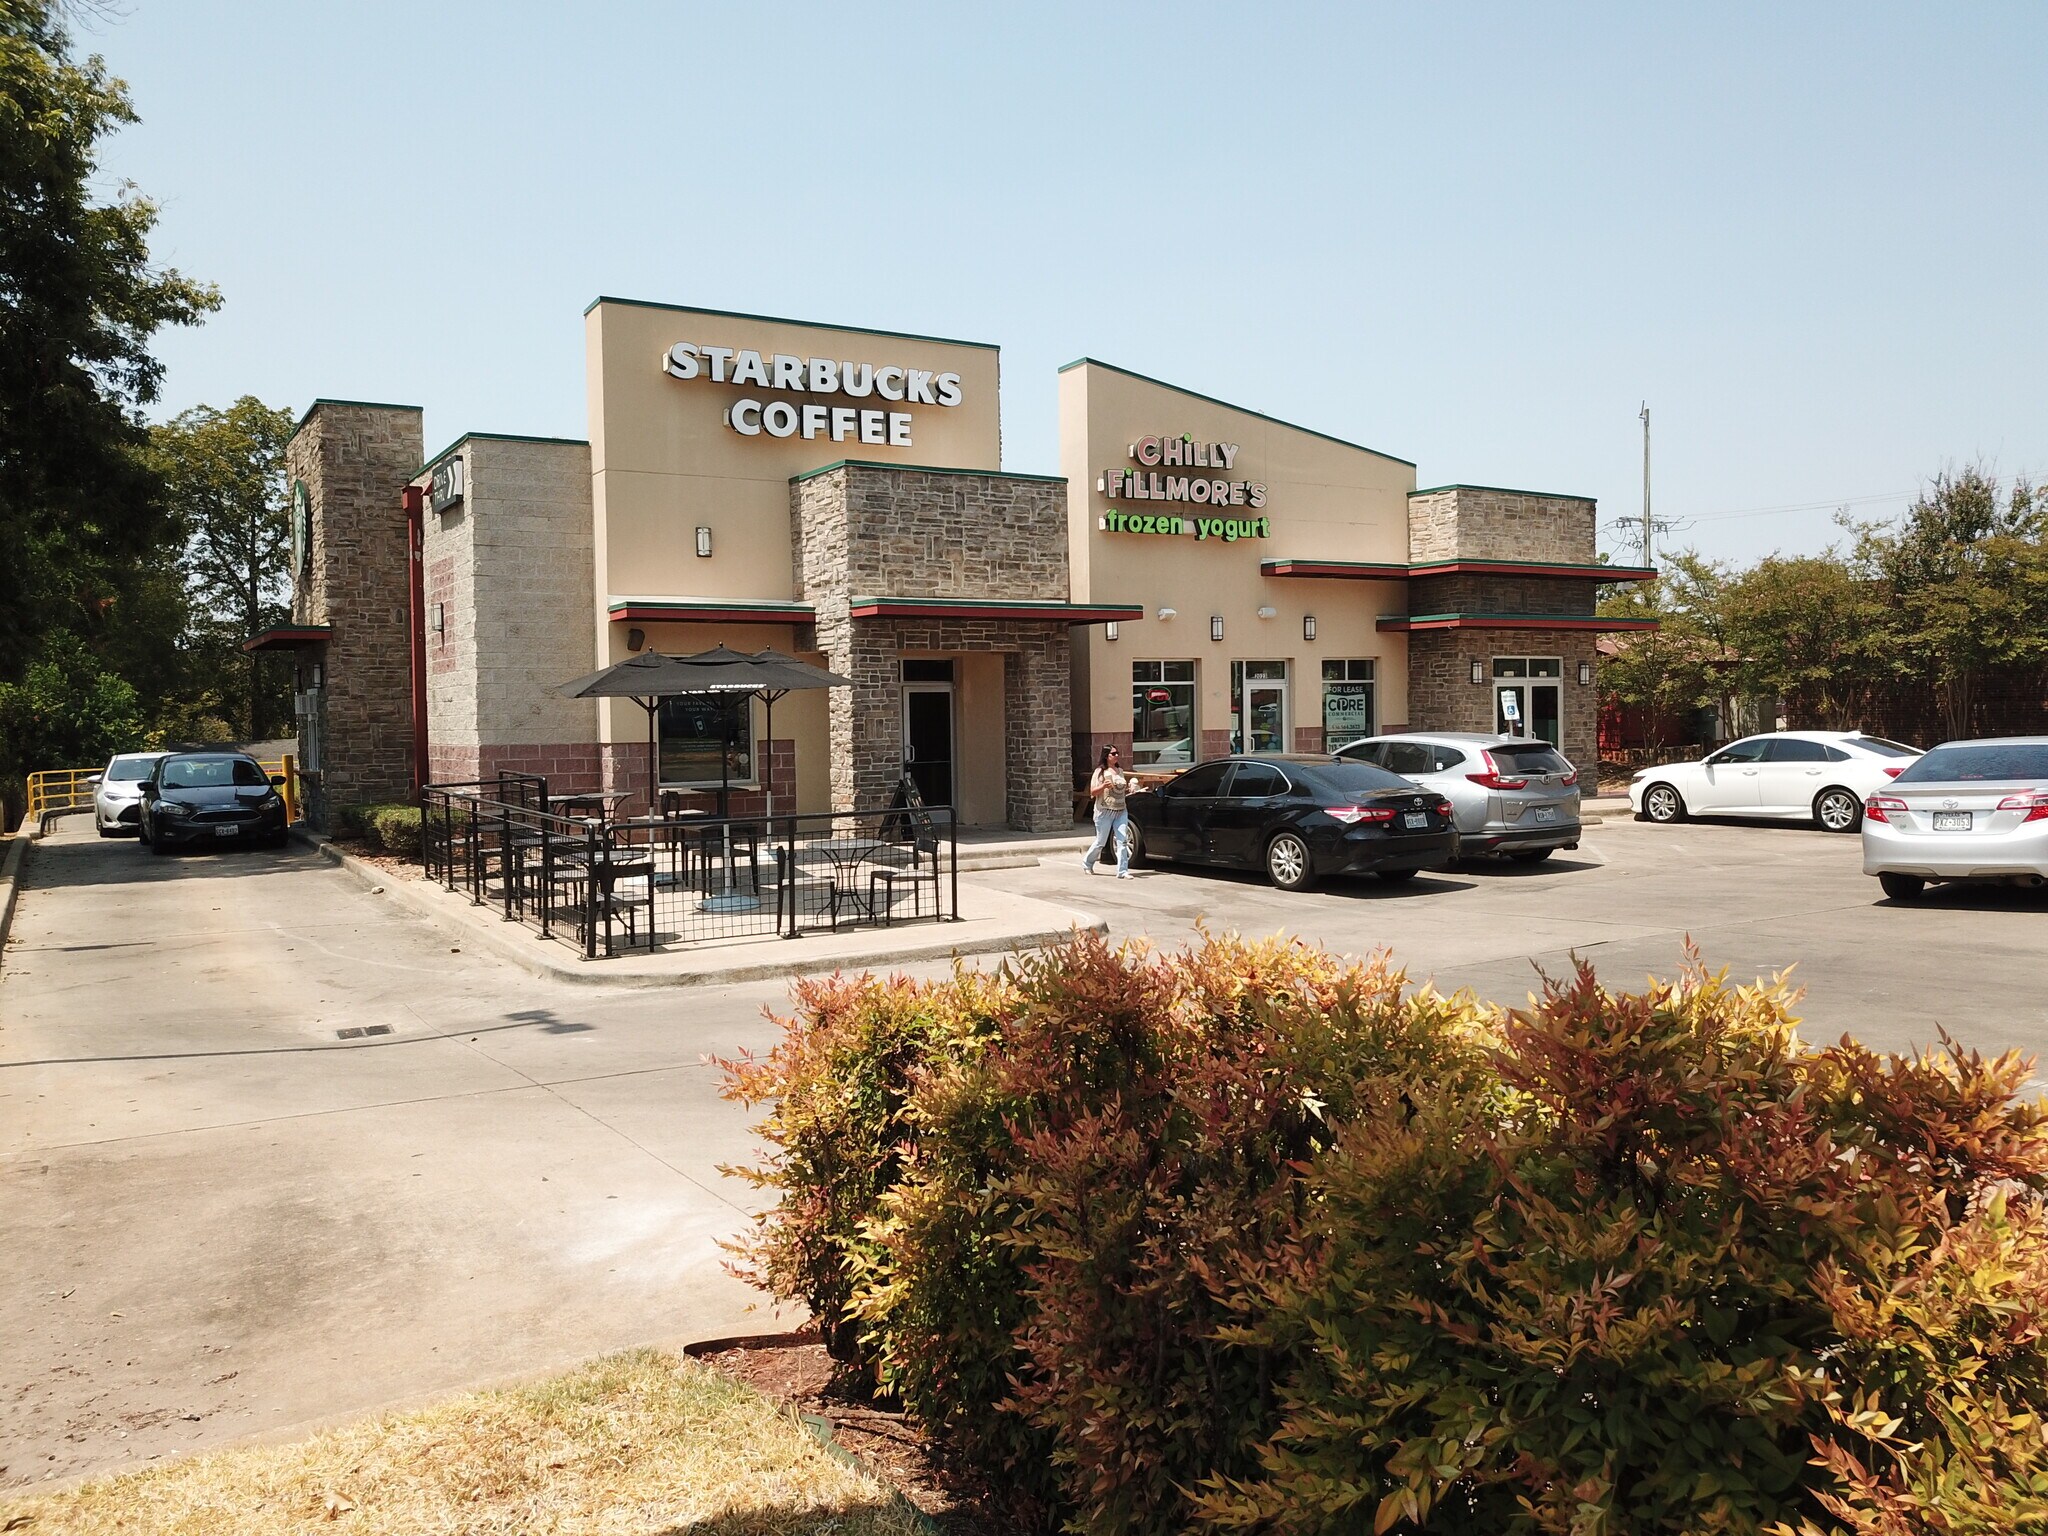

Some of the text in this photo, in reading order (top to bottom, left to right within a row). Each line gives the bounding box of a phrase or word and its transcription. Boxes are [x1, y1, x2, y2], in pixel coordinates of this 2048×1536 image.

[668, 341, 963, 408] STARBUCKS
[729, 398, 913, 447] COFFEE
[1107, 508, 1184, 535] frozen
[1195, 516, 1271, 543] yogurt
